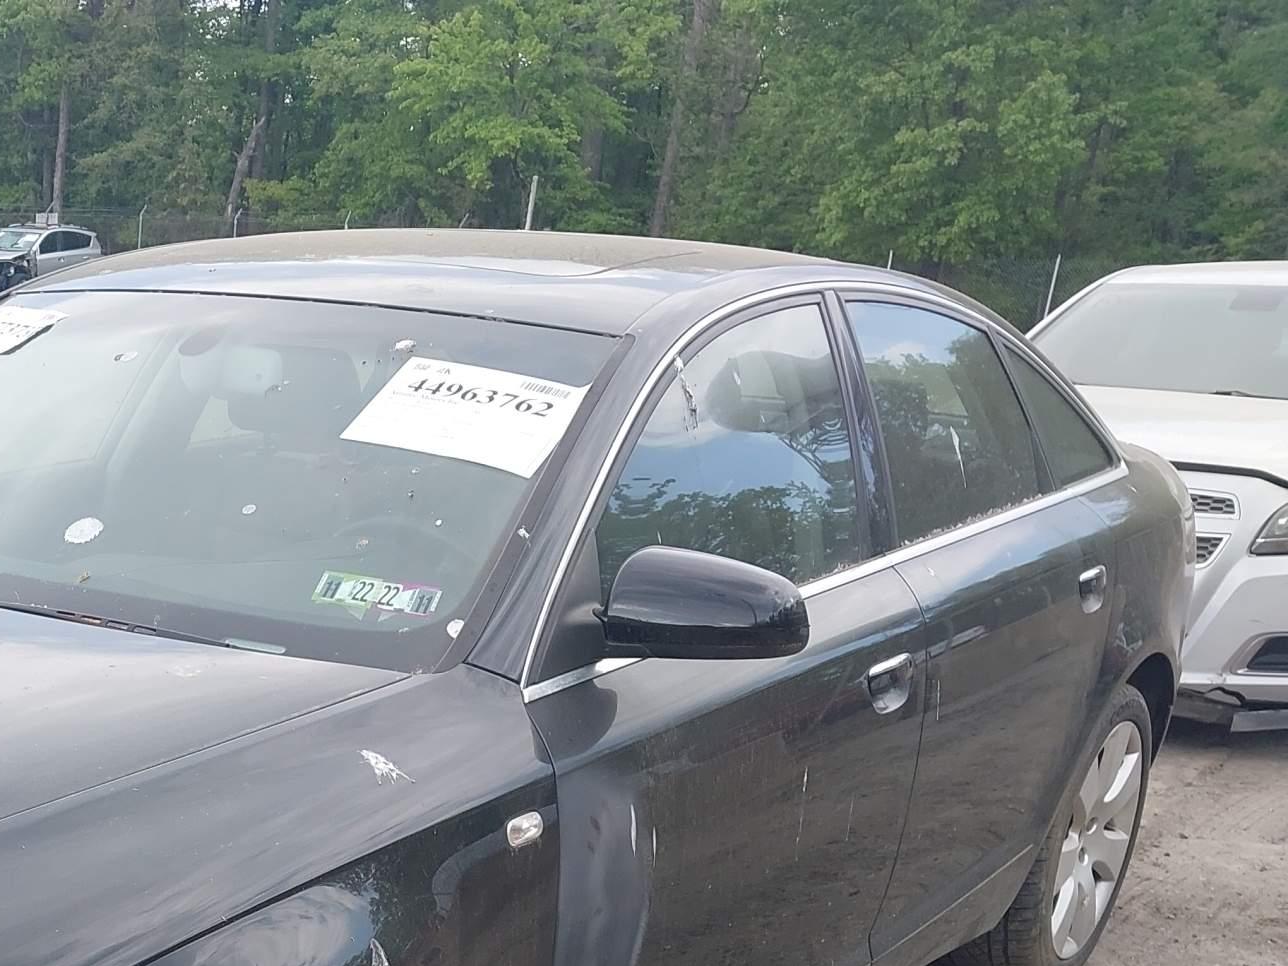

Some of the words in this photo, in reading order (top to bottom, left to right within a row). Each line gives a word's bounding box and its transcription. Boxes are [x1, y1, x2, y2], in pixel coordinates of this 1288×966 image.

[407, 378, 554, 416] 44963762
[322, 580, 342, 599] 11
[352, 581, 375, 602] 22
[377, 585, 400, 606] 22
[411, 595, 433, 613] 11
